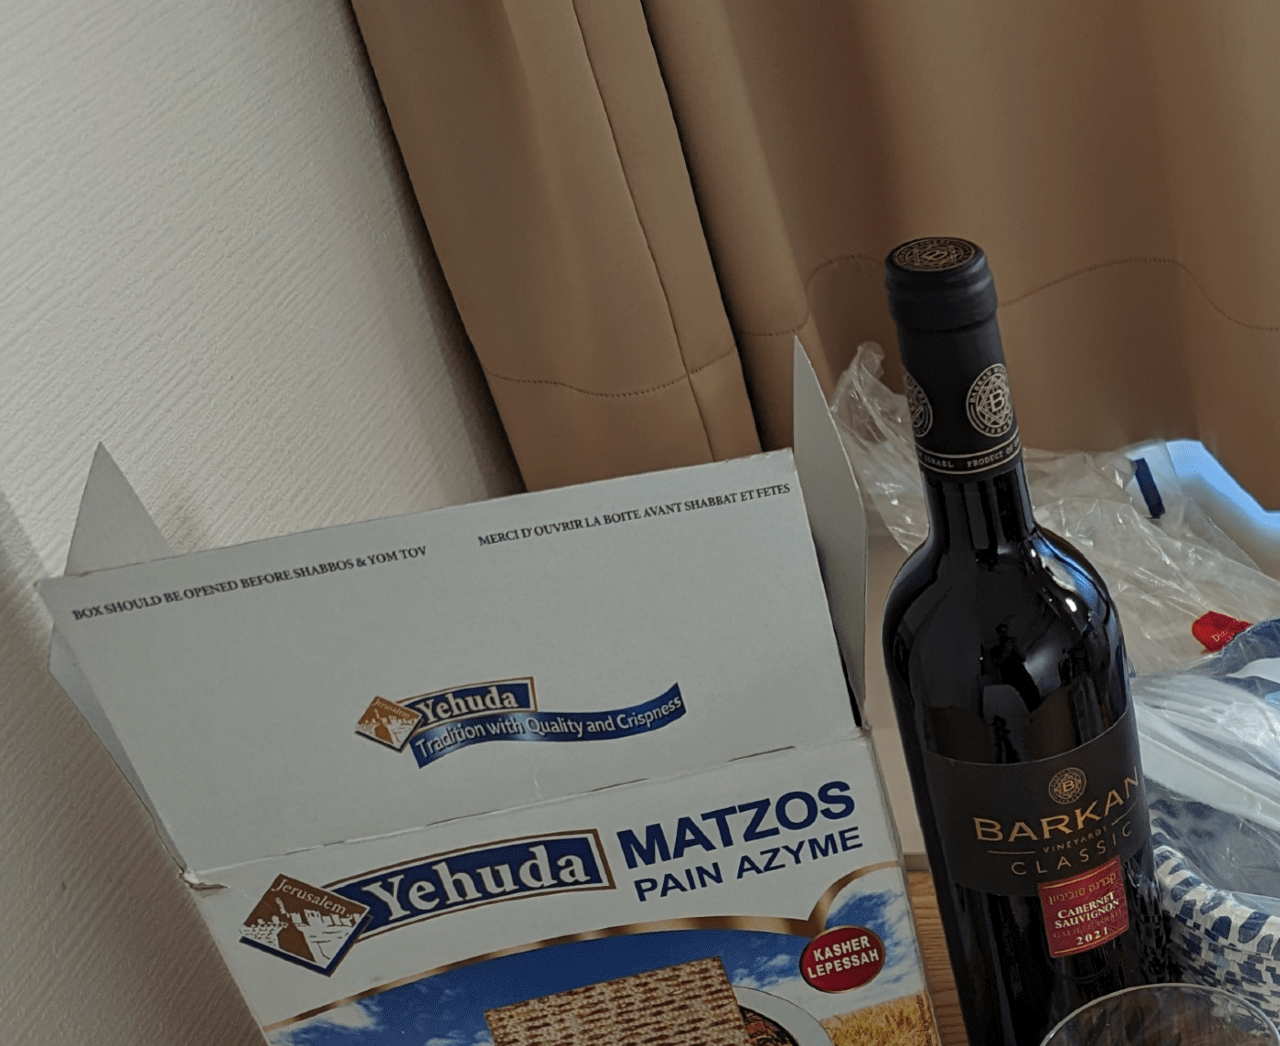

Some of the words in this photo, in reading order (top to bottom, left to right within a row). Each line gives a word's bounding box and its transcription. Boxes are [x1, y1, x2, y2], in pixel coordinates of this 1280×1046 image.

[989, 389, 1005, 412] B
[966, 451, 1004, 468] PRODUCT
[478, 529, 520, 546] MERCI
[585, 516, 601, 528] LA
[603, 508, 642, 525] BOITE
[643, 502, 682, 518] AVANT
[684, 491, 738, 512] SHABBAT
[740, 489, 755, 502] ET
[756, 482, 791, 499] FETES
[72, 603, 104, 620] BOX
[103, 595, 163, 615] SHOULD
[163, 592, 183, 603] BE
[183, 579, 239, 599] OPENED
[240, 568, 293, 589] BEFORE
[293, 556, 355, 579] SHABBOS
[356, 556, 367, 567] &
[366, 549, 399, 566] YOM
[399, 545, 427, 559] TOV
[415, 685, 520, 727] Yehuda
[415, 719, 484, 759] Tradition
[489, 712, 526, 740] with
[526, 712, 583, 738] Quality
[585, 714, 615, 732] and
[615, 694, 683, 730] Crispness
[973, 766, 1140, 843] BARKAN
[1062, 779, 1076, 793] B
[617, 781, 855, 868] MATZOS
[1043, 825, 1108, 853] VINEYARDS
[633, 862, 722, 903] PAIN
[735, 826, 864, 882] AZYME
[1011, 821, 1133, 875] CLASSIC
[270, 877, 346, 915] Jerusalem
[362, 848, 592, 923] Yehuda
[1054, 899, 1120, 930] SAUVIGNON
[1057, 891, 1116, 920] CABERNET
[813, 935, 871, 962] KASHER
[1076, 926, 1110, 946] 2021
[807, 948, 880, 979] LEPESSAH
